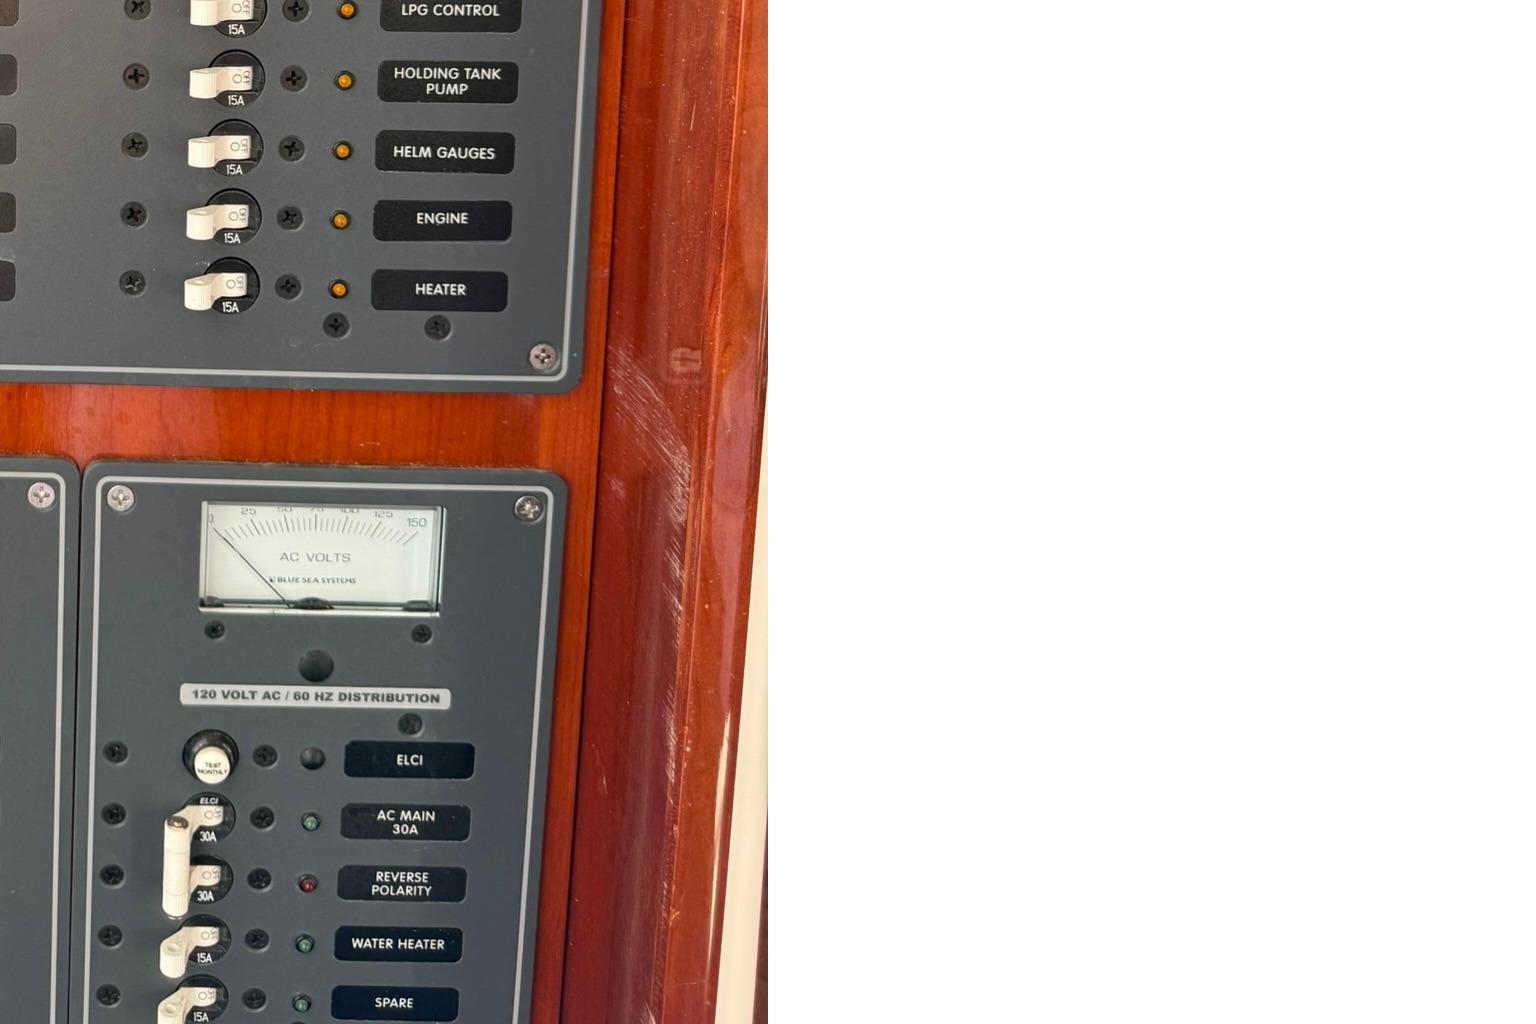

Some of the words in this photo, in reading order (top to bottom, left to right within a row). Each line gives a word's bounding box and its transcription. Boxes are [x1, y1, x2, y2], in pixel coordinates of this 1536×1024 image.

[401, 4, 429, 16] LPG
[433, 4, 500, 17] CONTROL
[228, 24, 245, 35] 15A
[394, 67, 459, 79] HOLDING
[463, 68, 501, 80] TANK
[426, 83, 468, 95] PUMP
[227, 95, 245, 106] 15A
[393, 146, 432, 158] HELM
[436, 146, 495, 160] GAUGES
[226, 164, 243, 175] 15A
[416, 212, 469, 225] ENGINE
[224, 233, 241, 244] 15A
[415, 283, 466, 296] HEATER
[222, 301, 239, 312] 15A
[408, 518, 426, 528] 150
[280, 553, 299, 562] AC
[306, 553, 351, 562] VOLTS
[193, 689, 217, 699] 120
[221, 690, 258, 700] VOLT
[262, 690, 282, 701] AC
[293, 691, 311, 702] 60
[314, 692, 334, 702] HZ
[338, 692, 440, 704] DISTRIBUTION
[396, 754, 423, 766] ELCI
[377, 810, 396, 822] AC
[400, 810, 436, 823] MAIN
[392, 823, 419, 835] 30A
[200, 830, 217, 842] 30A
[376, 871, 429, 884] REVERSE
[197, 890, 214, 902] 30A
[371, 884, 433, 897] POLARITY
[352, 937, 393, 950] WATER
[397, 938, 445, 951] HEATER
[197, 952, 213, 963] 15A
[375, 997, 413, 1009] SPARE
[194, 1011, 209, 1022] 15A
